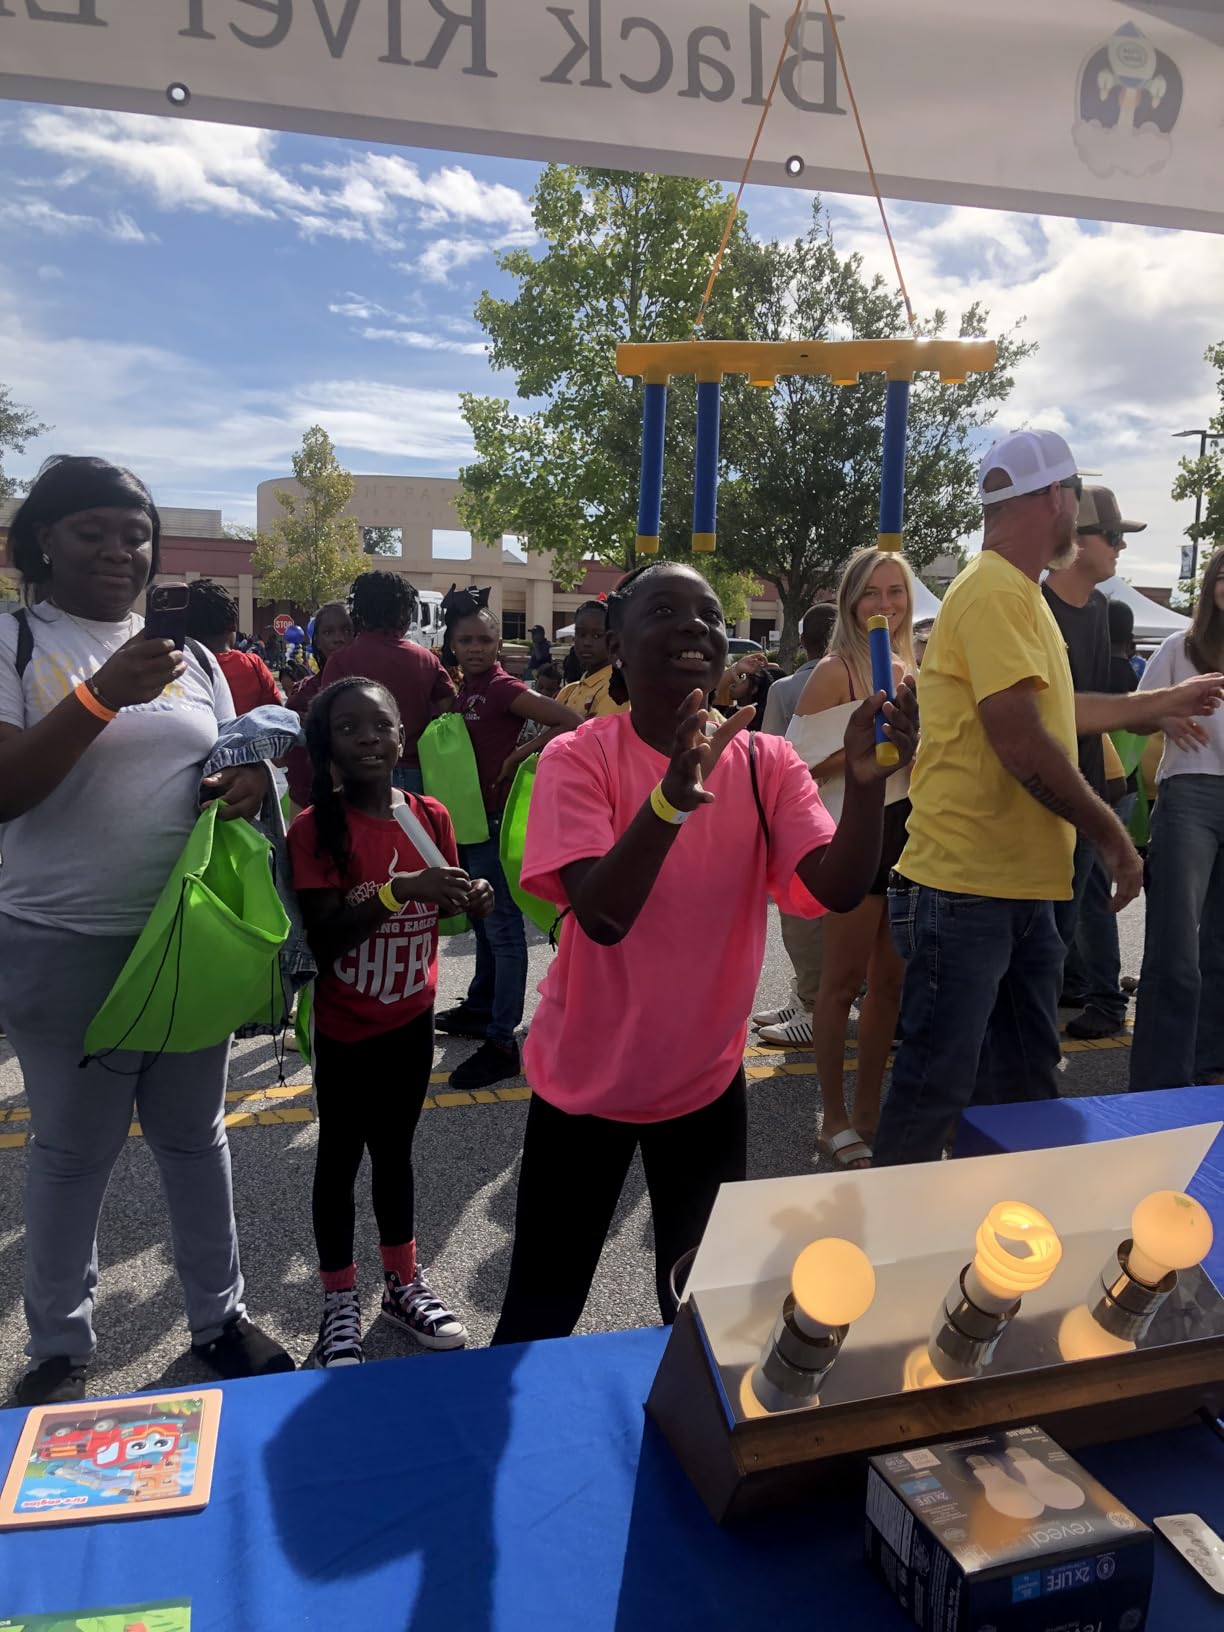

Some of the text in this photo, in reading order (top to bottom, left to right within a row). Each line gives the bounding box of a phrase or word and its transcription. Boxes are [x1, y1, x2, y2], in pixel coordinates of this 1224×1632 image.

[376, 917, 437, 934] NG EAGLES
[1027, 1520, 1095, 1550] reveal
[1046, 1570, 1073, 1592] LIFE
[1075, 1566, 1090, 1583] 2x
